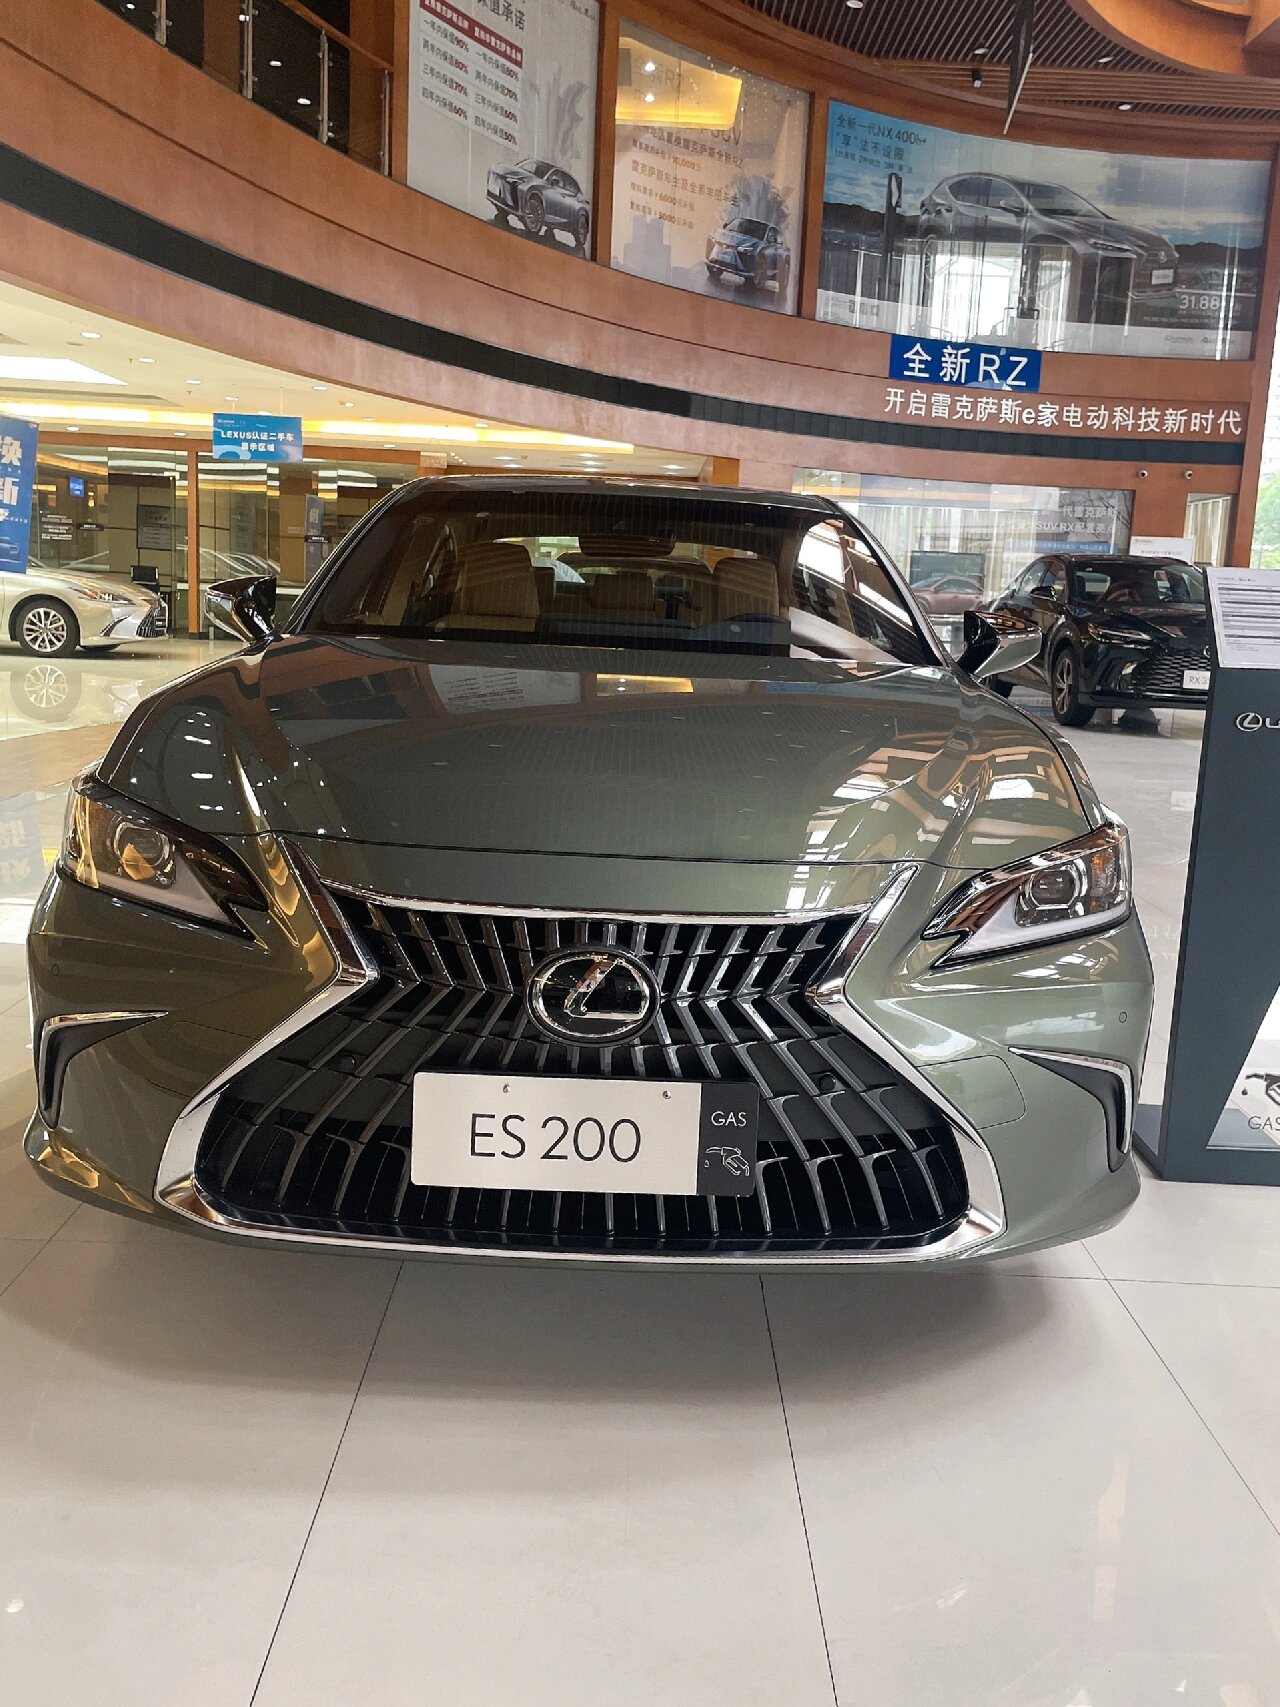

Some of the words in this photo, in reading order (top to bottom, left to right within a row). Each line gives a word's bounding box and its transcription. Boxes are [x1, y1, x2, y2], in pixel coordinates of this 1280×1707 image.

[903, 342, 1029, 387] 全新RZ
[884, 388, 1242, 436] 开启雷克萨斯e家电动科技新时代
[221, 430, 294, 442] LEXUS认证二手车
[470, 1113, 526, 1159] ES
[540, 1115, 641, 1163] 200
[710, 1110, 747, 1127] GAS
